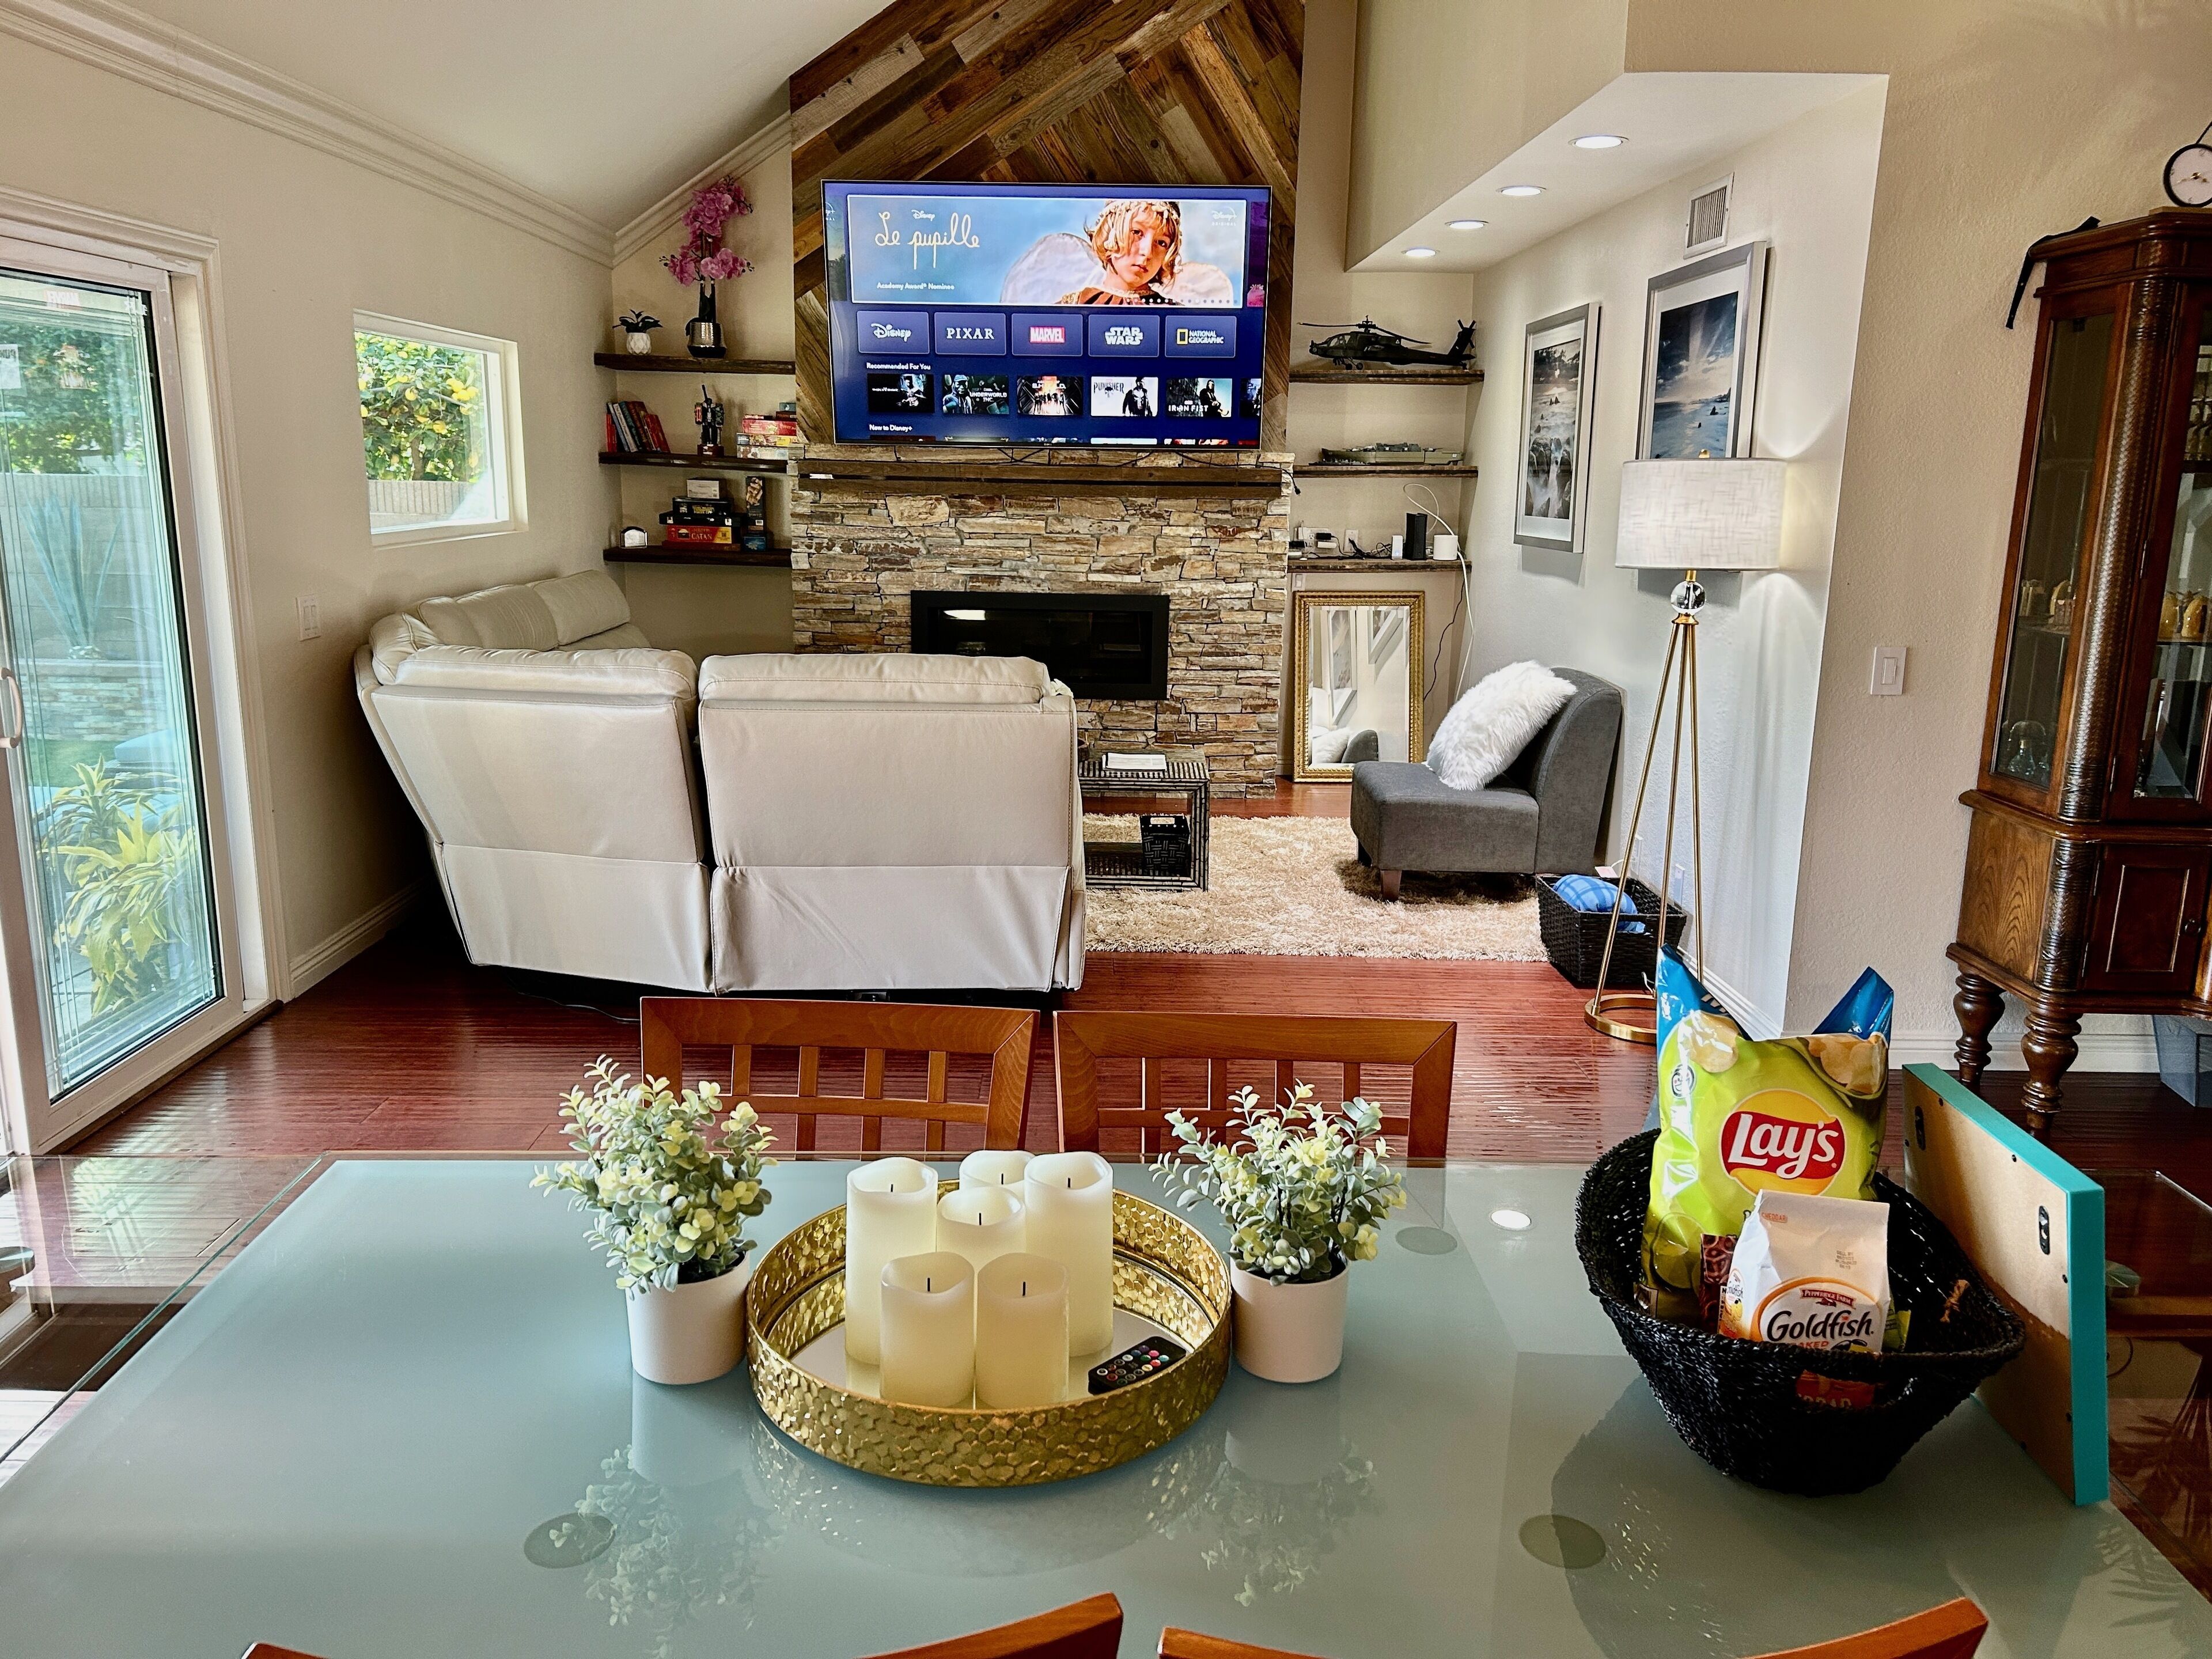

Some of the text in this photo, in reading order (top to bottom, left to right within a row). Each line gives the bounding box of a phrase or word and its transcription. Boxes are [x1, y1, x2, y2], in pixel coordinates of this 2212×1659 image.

[874, 211, 979, 270] Le pupille
[877, 282, 904, 290] Academy
[946, 327, 995, 340] PIXAR
[1030, 327, 1065, 343] MARVEL
[1105, 327, 1143, 336] STAR
[1105, 336, 1143, 345] WARS
[866, 362, 908, 370] Recommended
[920, 363, 931, 371] You
[1094, 382, 1124, 393] PUNISHER
[1728, 1113, 1839, 1179] Lay's
[1804, 1290, 1851, 1305] PEPPERIDGE FARM
